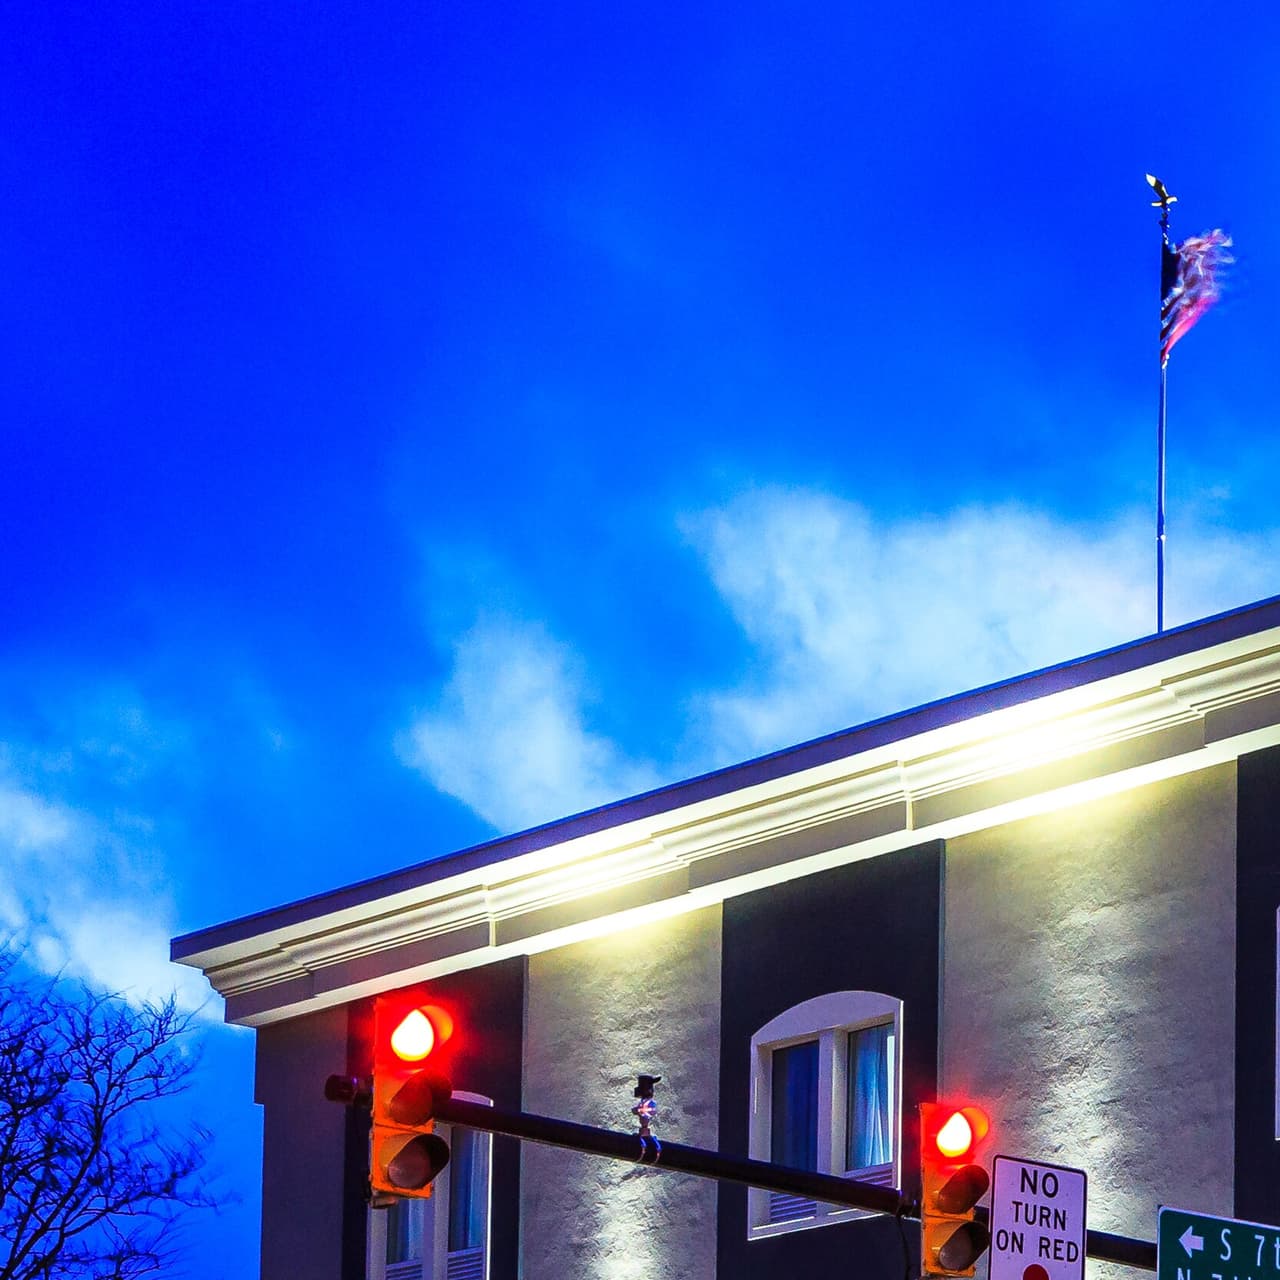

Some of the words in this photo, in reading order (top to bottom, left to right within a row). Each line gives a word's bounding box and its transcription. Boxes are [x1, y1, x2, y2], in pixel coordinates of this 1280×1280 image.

[1020, 1167, 1060, 1199] NO
[1012, 1200, 1067, 1231] TURN
[996, 1229, 1024, 1254] ON
[1038, 1236, 1079, 1263] RED
[1220, 1228, 1232, 1261] S
